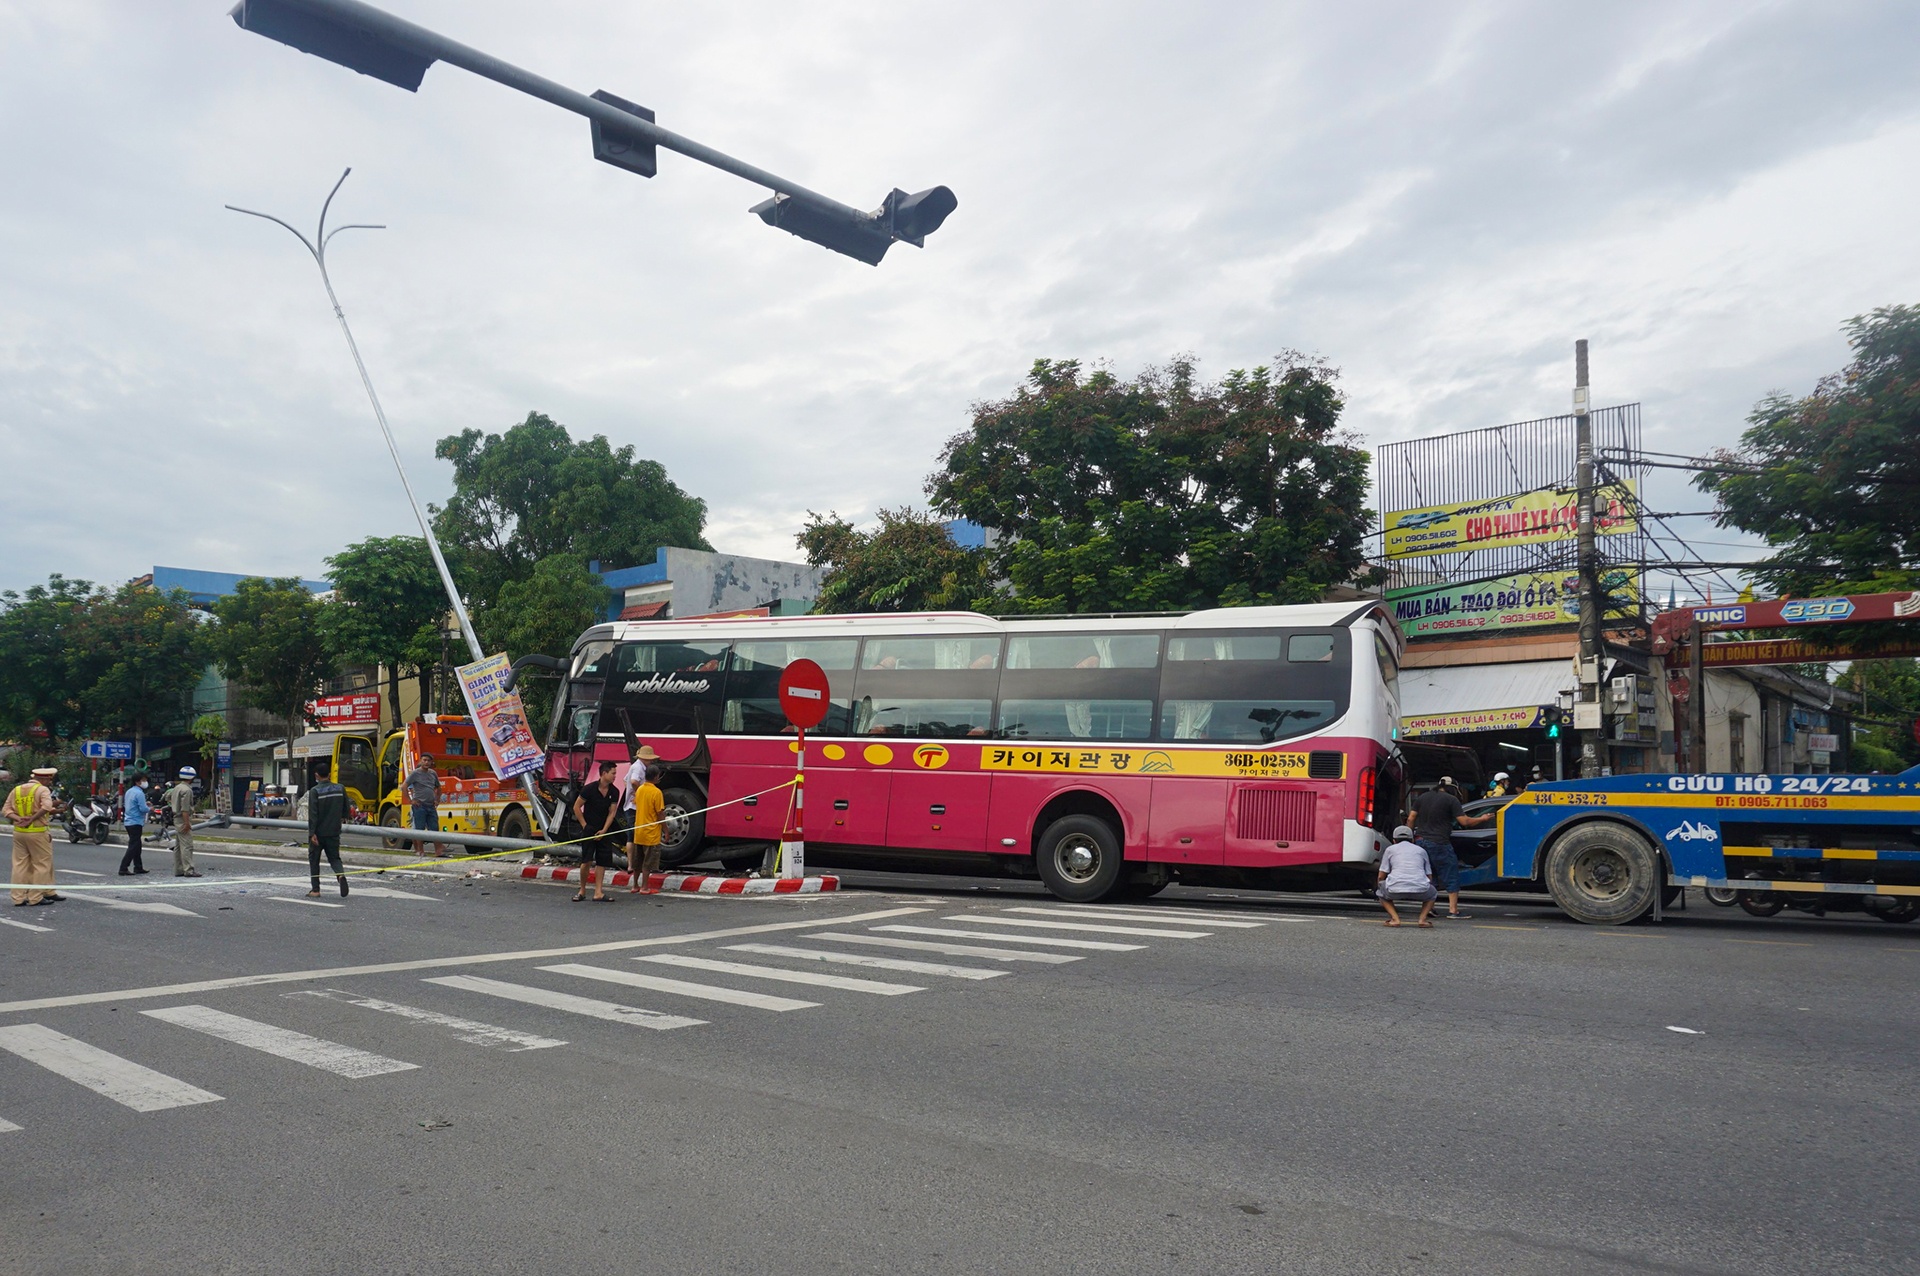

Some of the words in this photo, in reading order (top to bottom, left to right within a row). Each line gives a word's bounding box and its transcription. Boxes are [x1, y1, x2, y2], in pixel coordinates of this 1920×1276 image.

[1465, 517, 1492, 543] CHO
[1495, 505, 1528, 540] THUÊ
[1532, 509, 1548, 536] XE
[1391, 537, 1402, 545] LH
[1405, 530, 1457, 543] 0906.511.602
[1396, 601, 1422, 620] MUA
[1425, 594, 1450, 617] BÁN
[1461, 593, 1493, 614] TRAO
[1497, 579, 1522, 610] ĐỔI
[1525, 584, 1534, 607] Ô
[1695, 608, 1744, 623] UNIC
[1784, 602, 1849, 618] 330
[1417, 623, 1429, 631] LH
[1432, 617, 1485, 629] 0906.511.602
[1500, 611, 1556, 624] 0903.511.602
[1703, 645, 1723, 662] DÂN
[1726, 643, 1755, 660] ĐOÀN
[1758, 639, 1778, 659] KẾT
[1781, 640, 1801, 657] XÂY
[623, 672, 710, 693] mobihome
[472, 683, 497, 700] LỊCH
[1410, 720, 1426, 728] CHO
[1450, 717, 1459, 725] XE
[1489, 714, 1494, 722] 4
[1503, 713, 1507, 721] 7
[1225, 753, 1306, 768] 36B-02558
[1668, 774, 1724, 792] CỨU
[1735, 774, 1772, 794] HỘ
[1781, 777, 1871, 794] 24/24
[1534, 793, 1556, 804] 43C
[1567, 793, 1608, 805] 252.72
[1716, 796, 1735, 806] ĐT:
[1739, 796, 1828, 808] 0905.711.063
